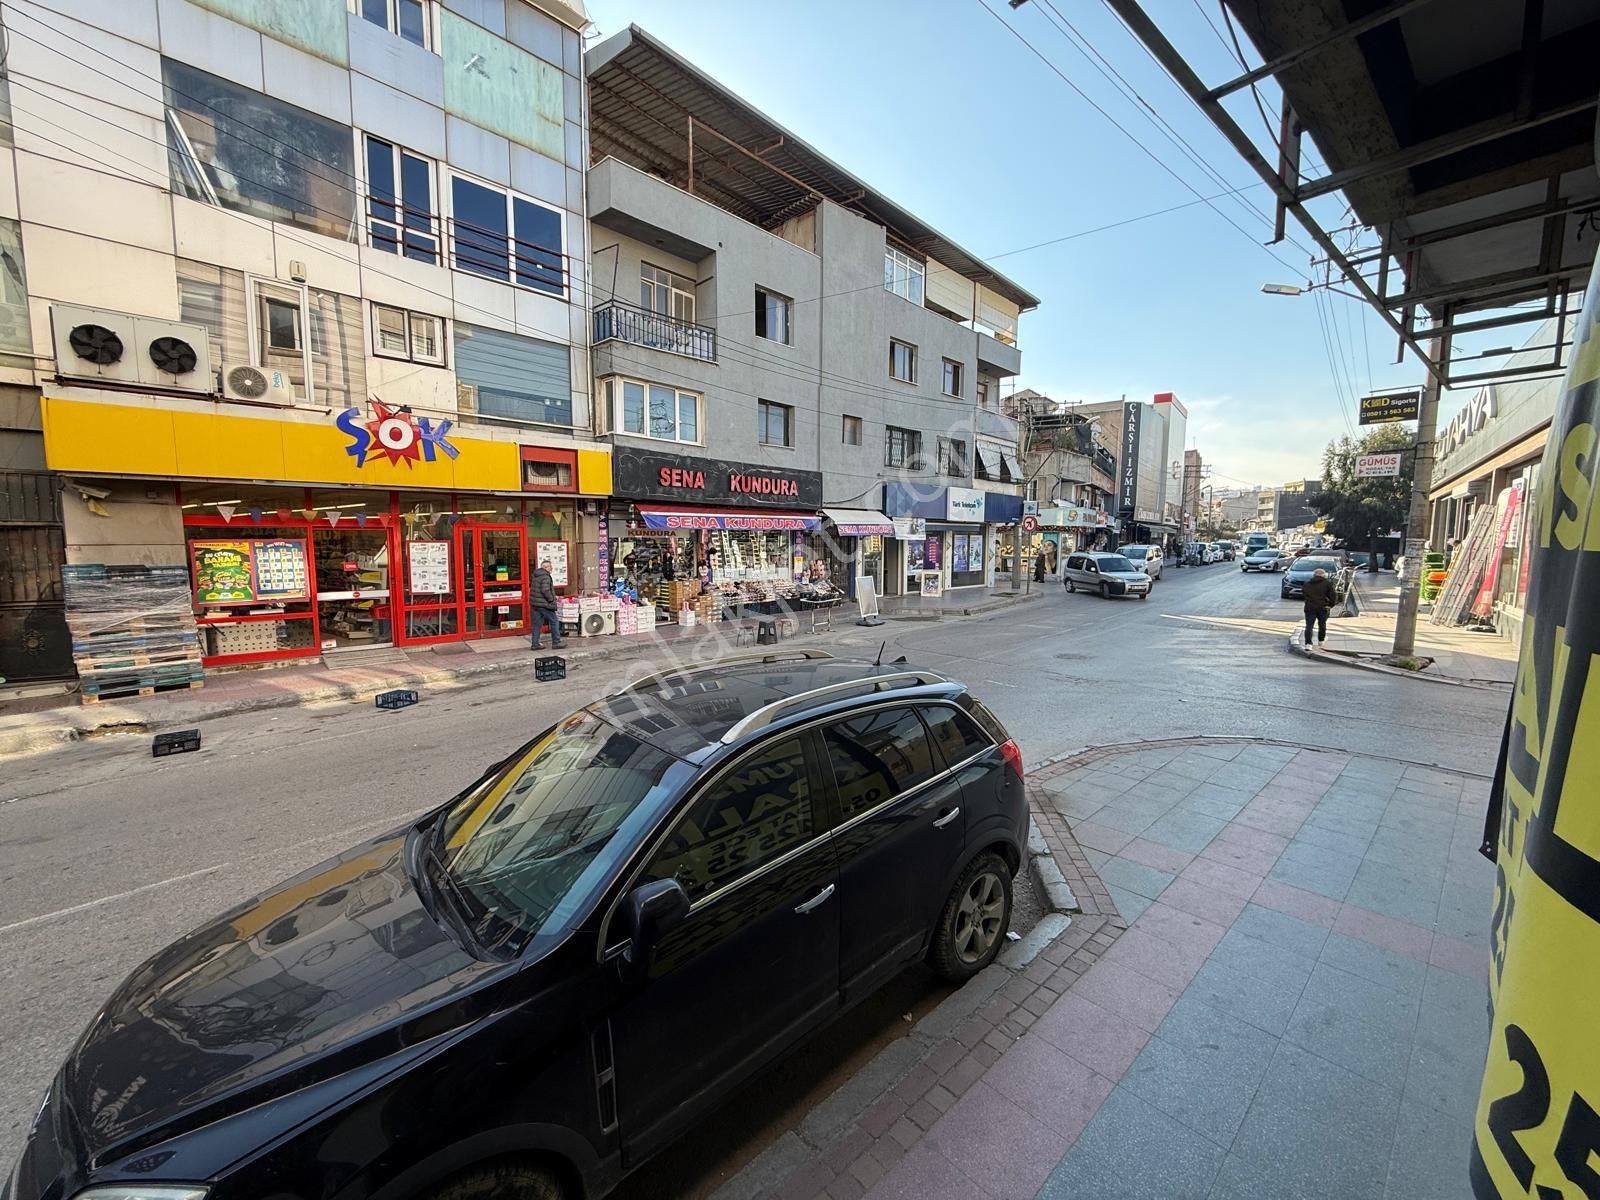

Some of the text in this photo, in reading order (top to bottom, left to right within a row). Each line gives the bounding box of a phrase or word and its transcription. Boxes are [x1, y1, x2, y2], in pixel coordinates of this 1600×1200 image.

[336, 405, 460, 469] ŞOK
[659, 467, 799, 496] SENA KUNDURA
[667, 516, 806, 530] SENA KUNDURA
